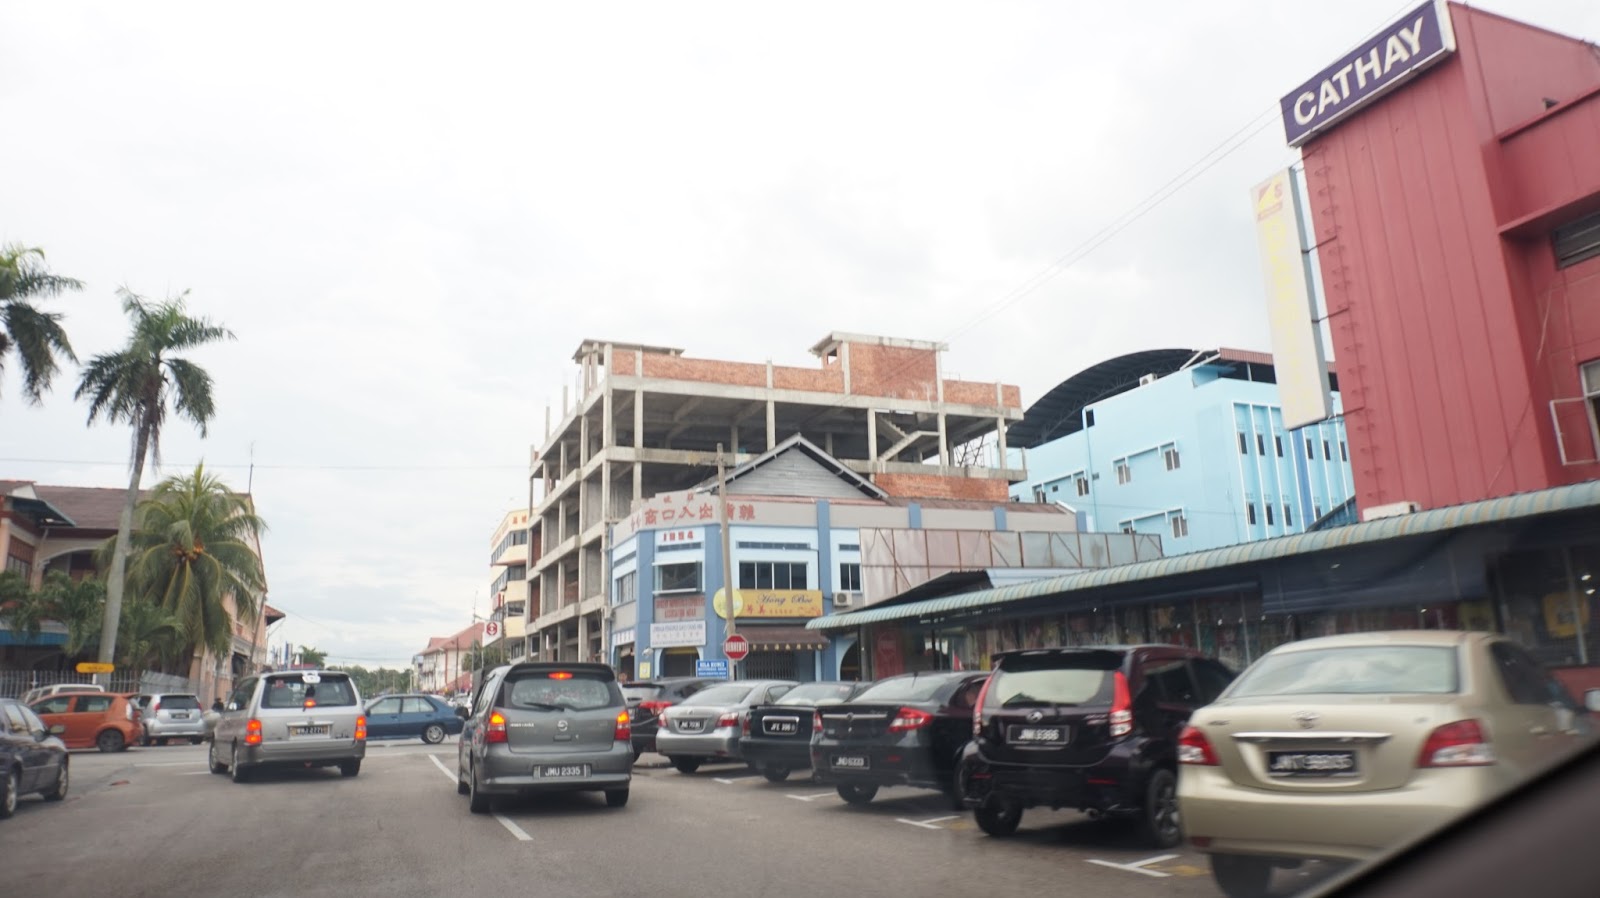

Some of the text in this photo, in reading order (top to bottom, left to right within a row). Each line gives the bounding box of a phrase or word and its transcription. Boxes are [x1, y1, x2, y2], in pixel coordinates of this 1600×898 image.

[1293, 16, 1424, 126] CATHAY
[544, 766, 581, 777] JMU 2335
